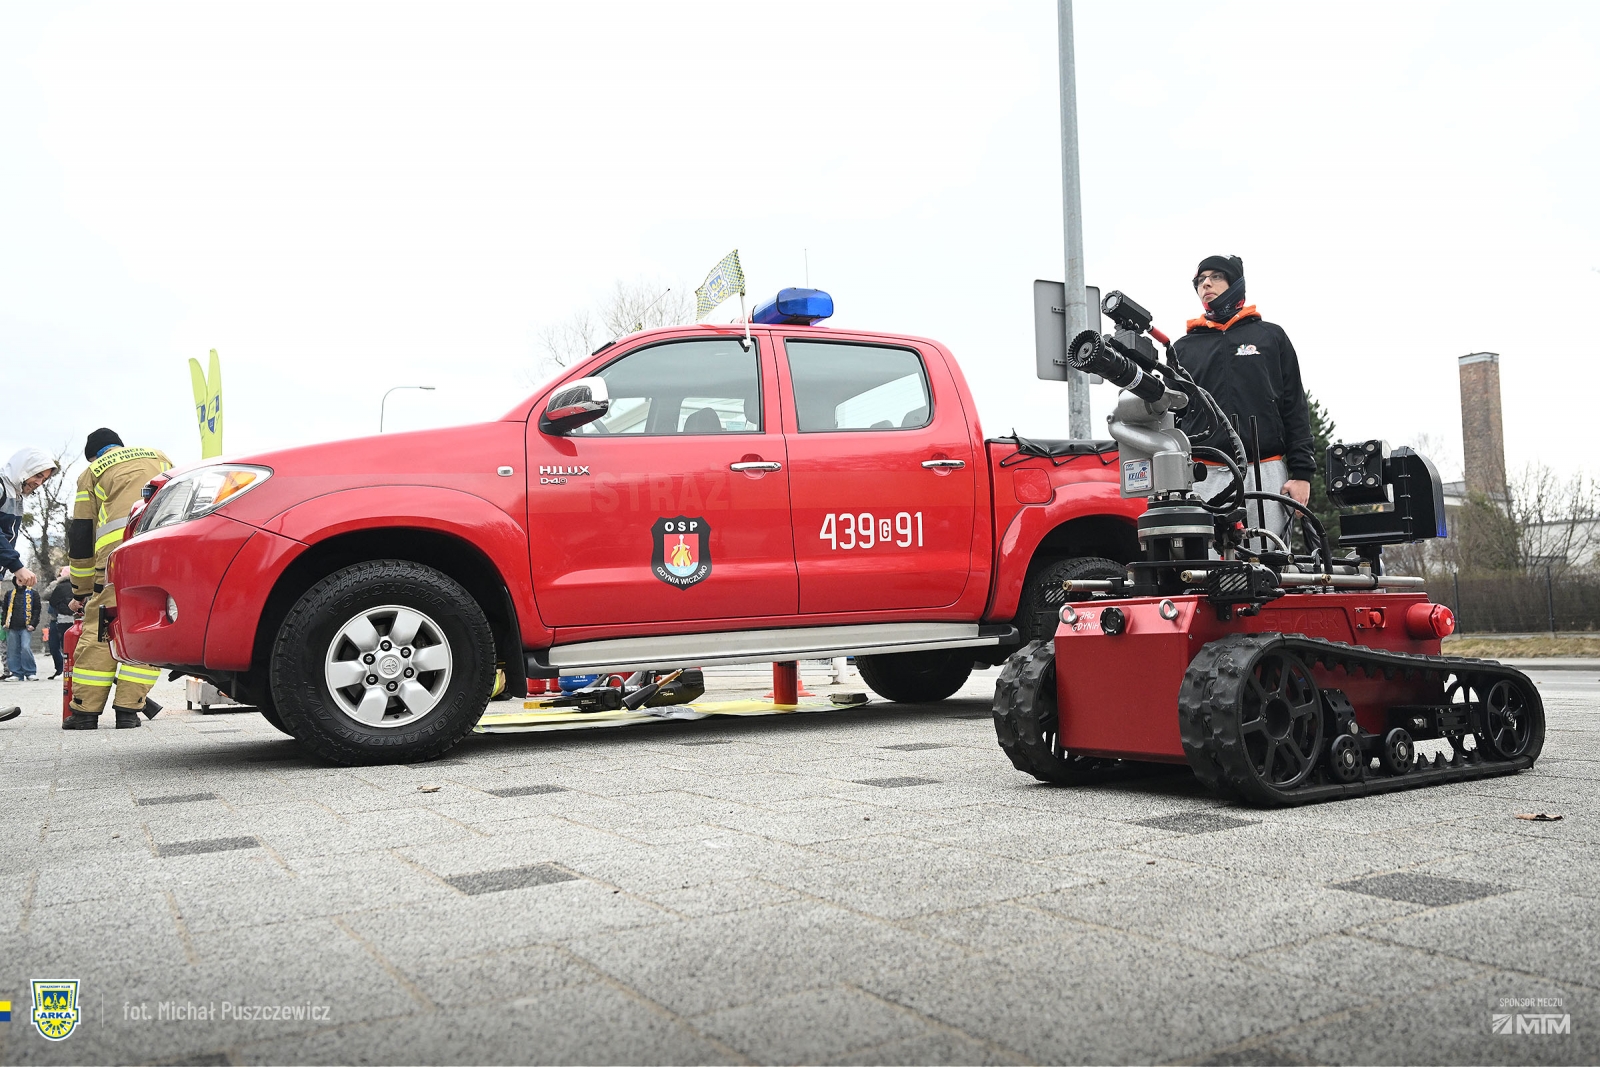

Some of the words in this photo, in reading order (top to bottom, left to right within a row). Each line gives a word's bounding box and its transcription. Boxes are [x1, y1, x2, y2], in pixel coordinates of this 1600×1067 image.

[539, 465, 590, 476] HILUX
[656, 566, 680, 585] GDYNIA
[679, 564, 708, 585] WICZLINO
[333, 690, 467, 747] GEOLANDAR
